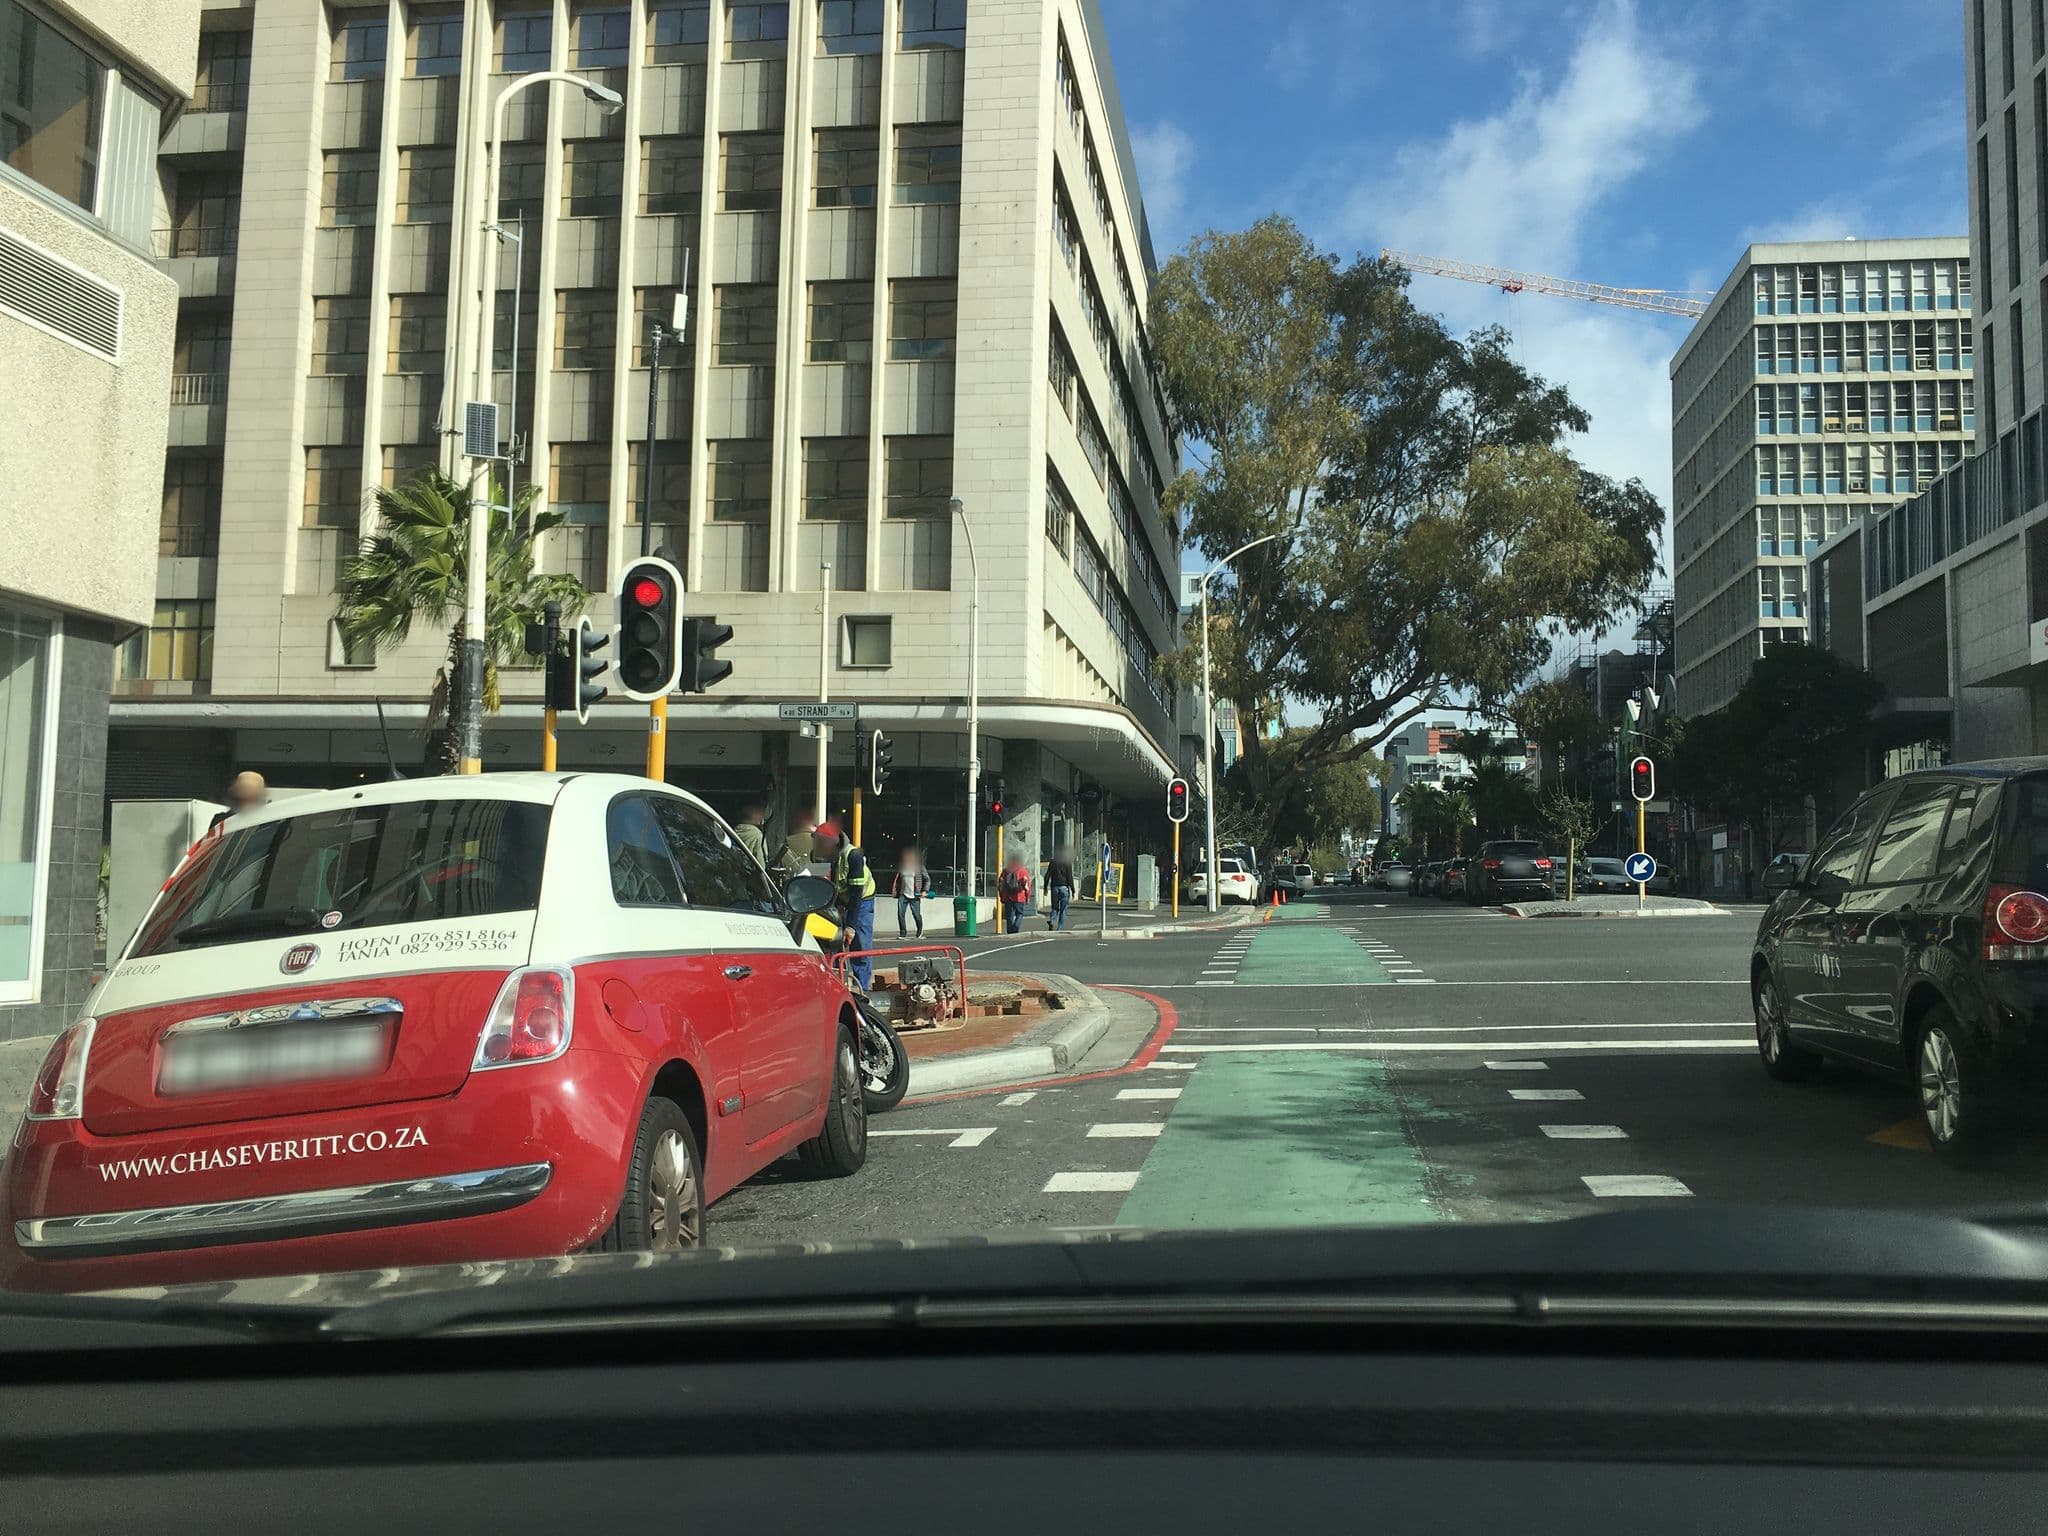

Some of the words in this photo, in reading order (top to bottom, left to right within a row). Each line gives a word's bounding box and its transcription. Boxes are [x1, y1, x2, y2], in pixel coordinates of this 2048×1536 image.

[797, 706, 829, 717] STRAND
[410, 932, 439, 943] 076
[444, 930, 471, 941] 851
[477, 929, 518, 940] 8164
[287, 950, 313, 966] FIAT
[338, 947, 391, 963] TANIA
[400, 943, 430, 955] 082
[435, 941, 464, 952] 929
[468, 940, 508, 951] 5536
[115, 964, 161, 978] GROUP
[1812, 953, 1842, 978] SLOTS
[99, 1126, 429, 1182] WWW.CHASEVERITT.CO.ZA
